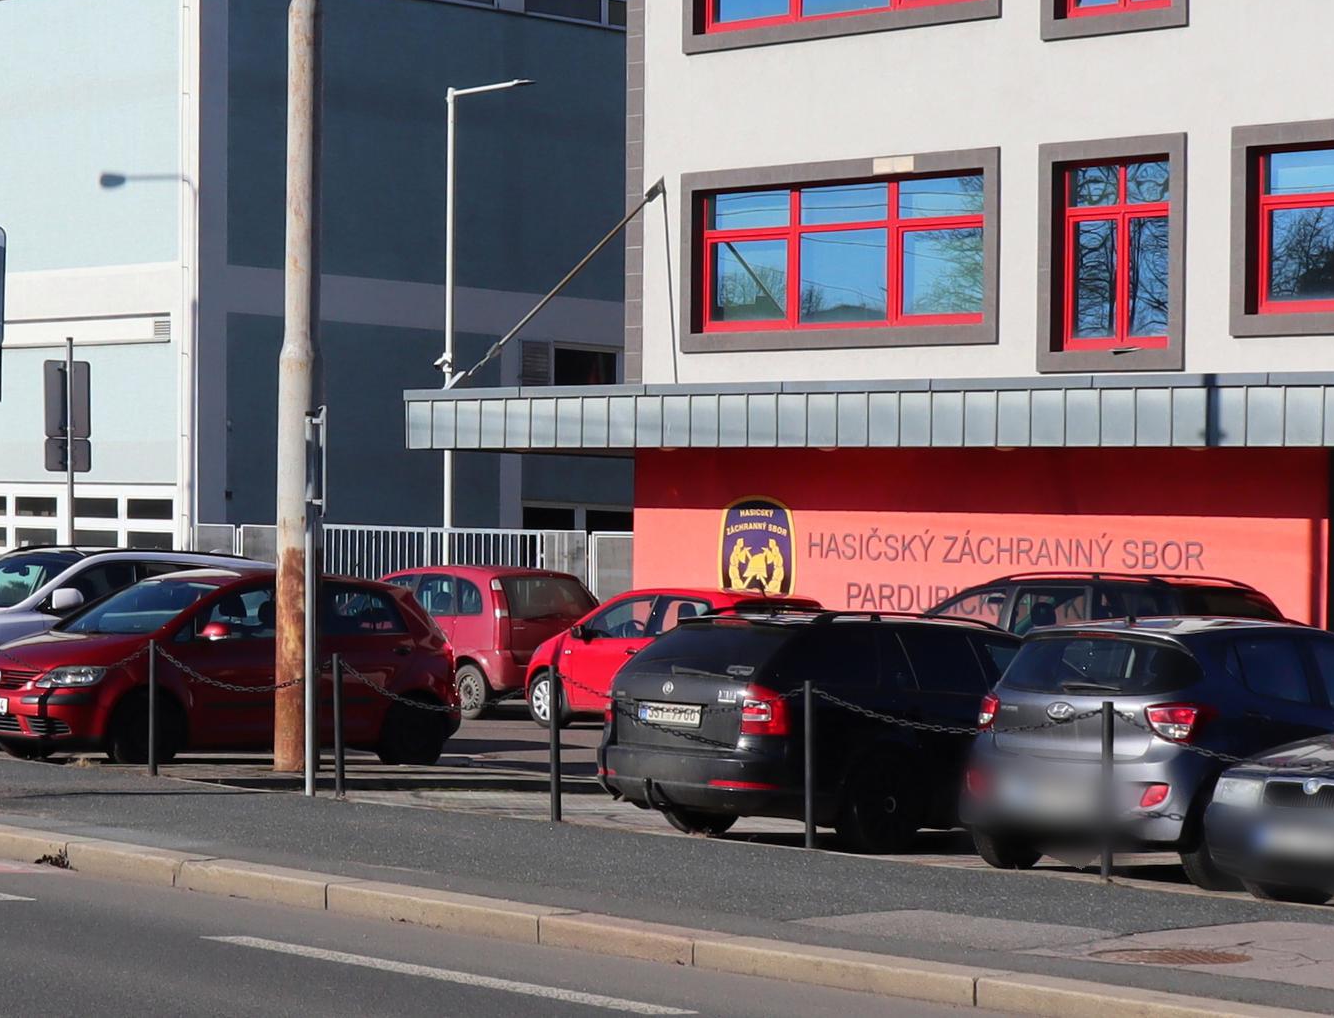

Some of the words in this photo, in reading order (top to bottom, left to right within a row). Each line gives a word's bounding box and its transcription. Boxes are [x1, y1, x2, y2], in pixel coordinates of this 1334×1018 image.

[767, 523, 787, 537] SBOR
[808, 528, 935, 562] HASIČSKÝ
[942, 530, 1113, 568] ZÁCHRANNÝ
[1122, 539, 1204, 571] SBOR
